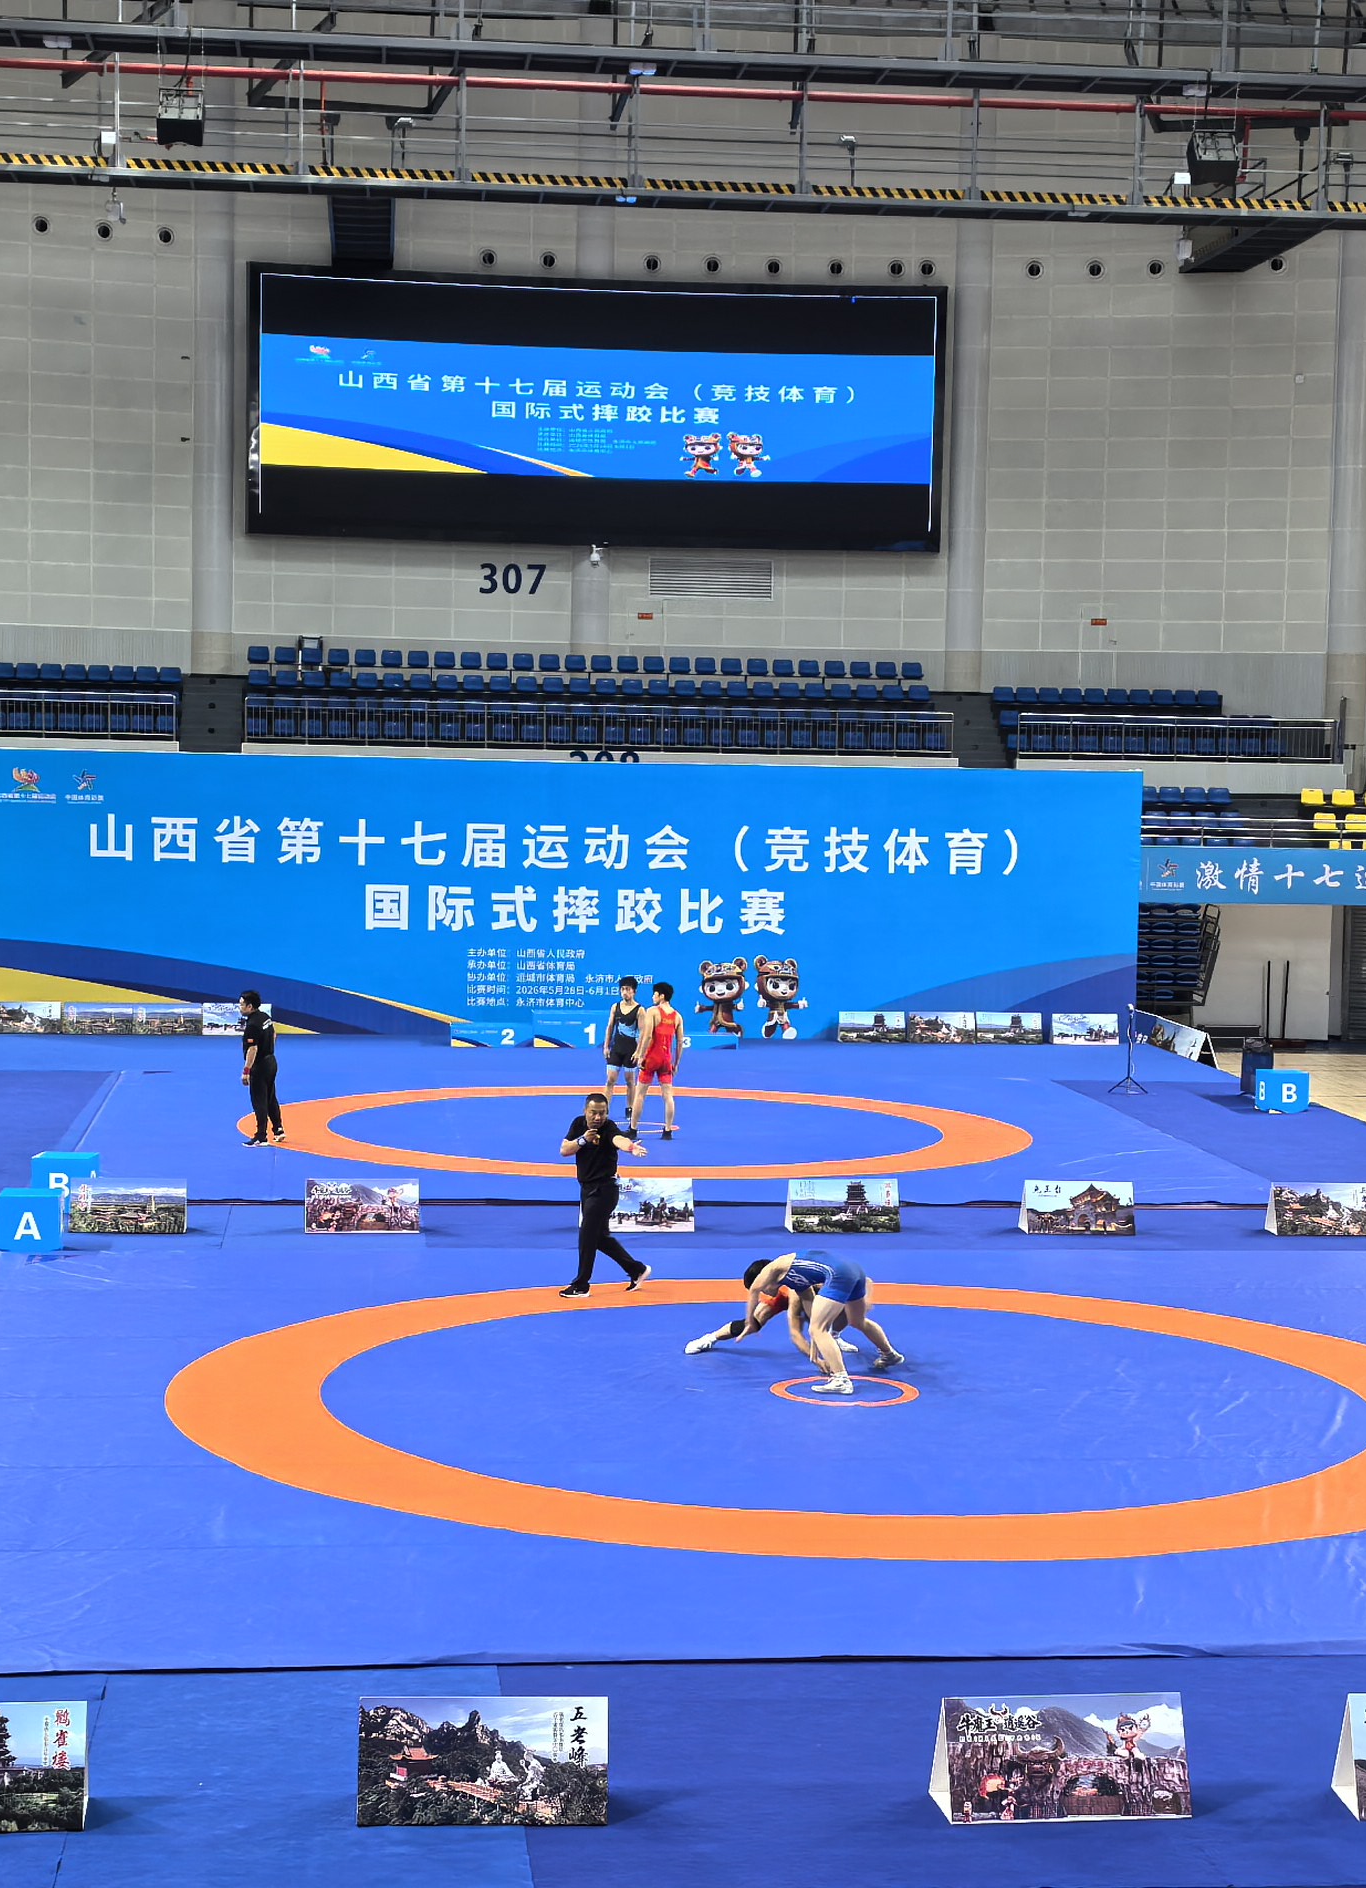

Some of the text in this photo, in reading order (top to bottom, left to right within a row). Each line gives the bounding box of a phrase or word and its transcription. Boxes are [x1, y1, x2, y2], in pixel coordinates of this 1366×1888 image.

[338, 369, 858, 406] 山西省第十七届运动会（竞技体育）
[490, 400, 721, 426] 国际式摔跤比赛
[478, 562, 547, 596] 307
[88, 812, 1021, 877] 山西省第十七届运动会（竞技体育）
[364, 883, 787, 937] 国际式摔跤比赛
[585, 973, 654, 985] 永济市人政府
[500, 1028, 516, 1046] 2
[583, 1022, 598, 1045] 1
[1258, 1080, 1267, 1101] B
[1281, 1082, 1298, 1104] B
[12, 1210, 43, 1241] A
[956, 1712, 997, 1735] 牛魔王
[568, 1705, 589, 1769] 五老峰
